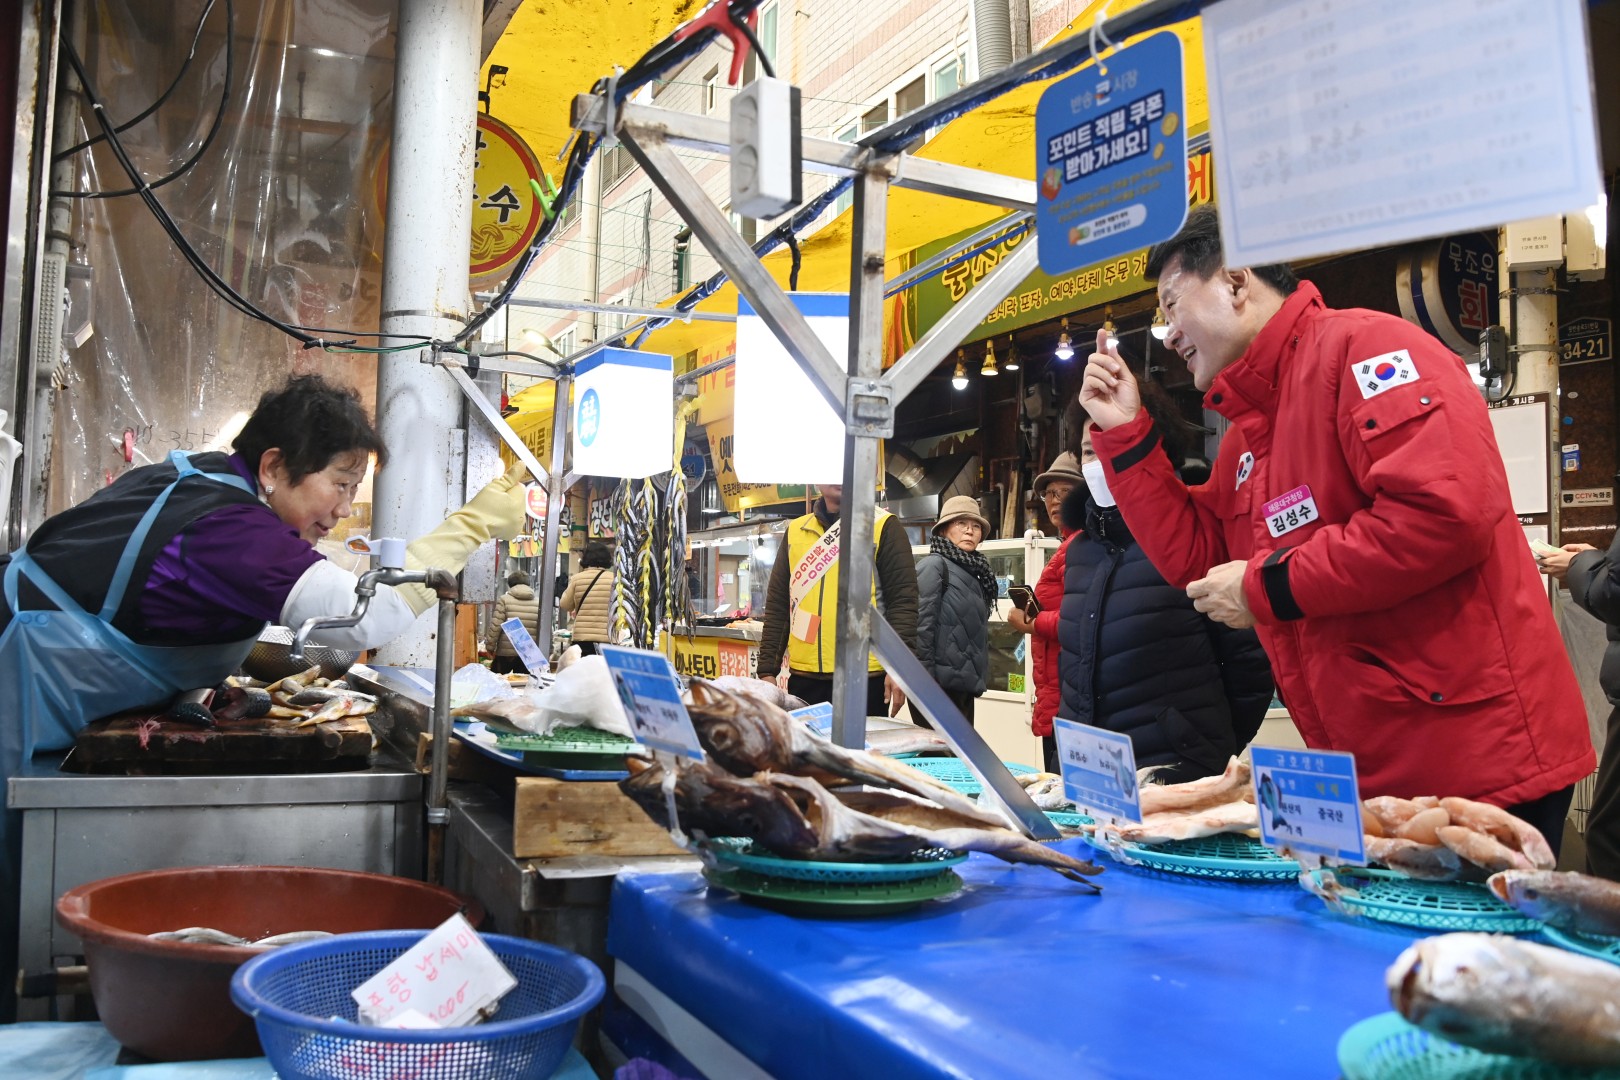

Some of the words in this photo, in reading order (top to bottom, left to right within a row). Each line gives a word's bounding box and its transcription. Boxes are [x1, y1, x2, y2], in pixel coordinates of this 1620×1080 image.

[1113, 70, 1138, 92] 시장
[1049, 123, 1091, 162] 포인트
[1095, 108, 1126, 138] 적립
[1129, 92, 1163, 124] 쿠폰
[1065, 127, 1149, 182] 받아가세요!
[1105, 259, 1129, 284] 주문
[1449, 242, 1496, 281] 물조은
[1458, 278, 1488, 330] 회
[1267, 489, 1304, 513] 해운대구청장
[1272, 504, 1312, 533] 김성수
[1317, 806, 1344, 823] 중국산
